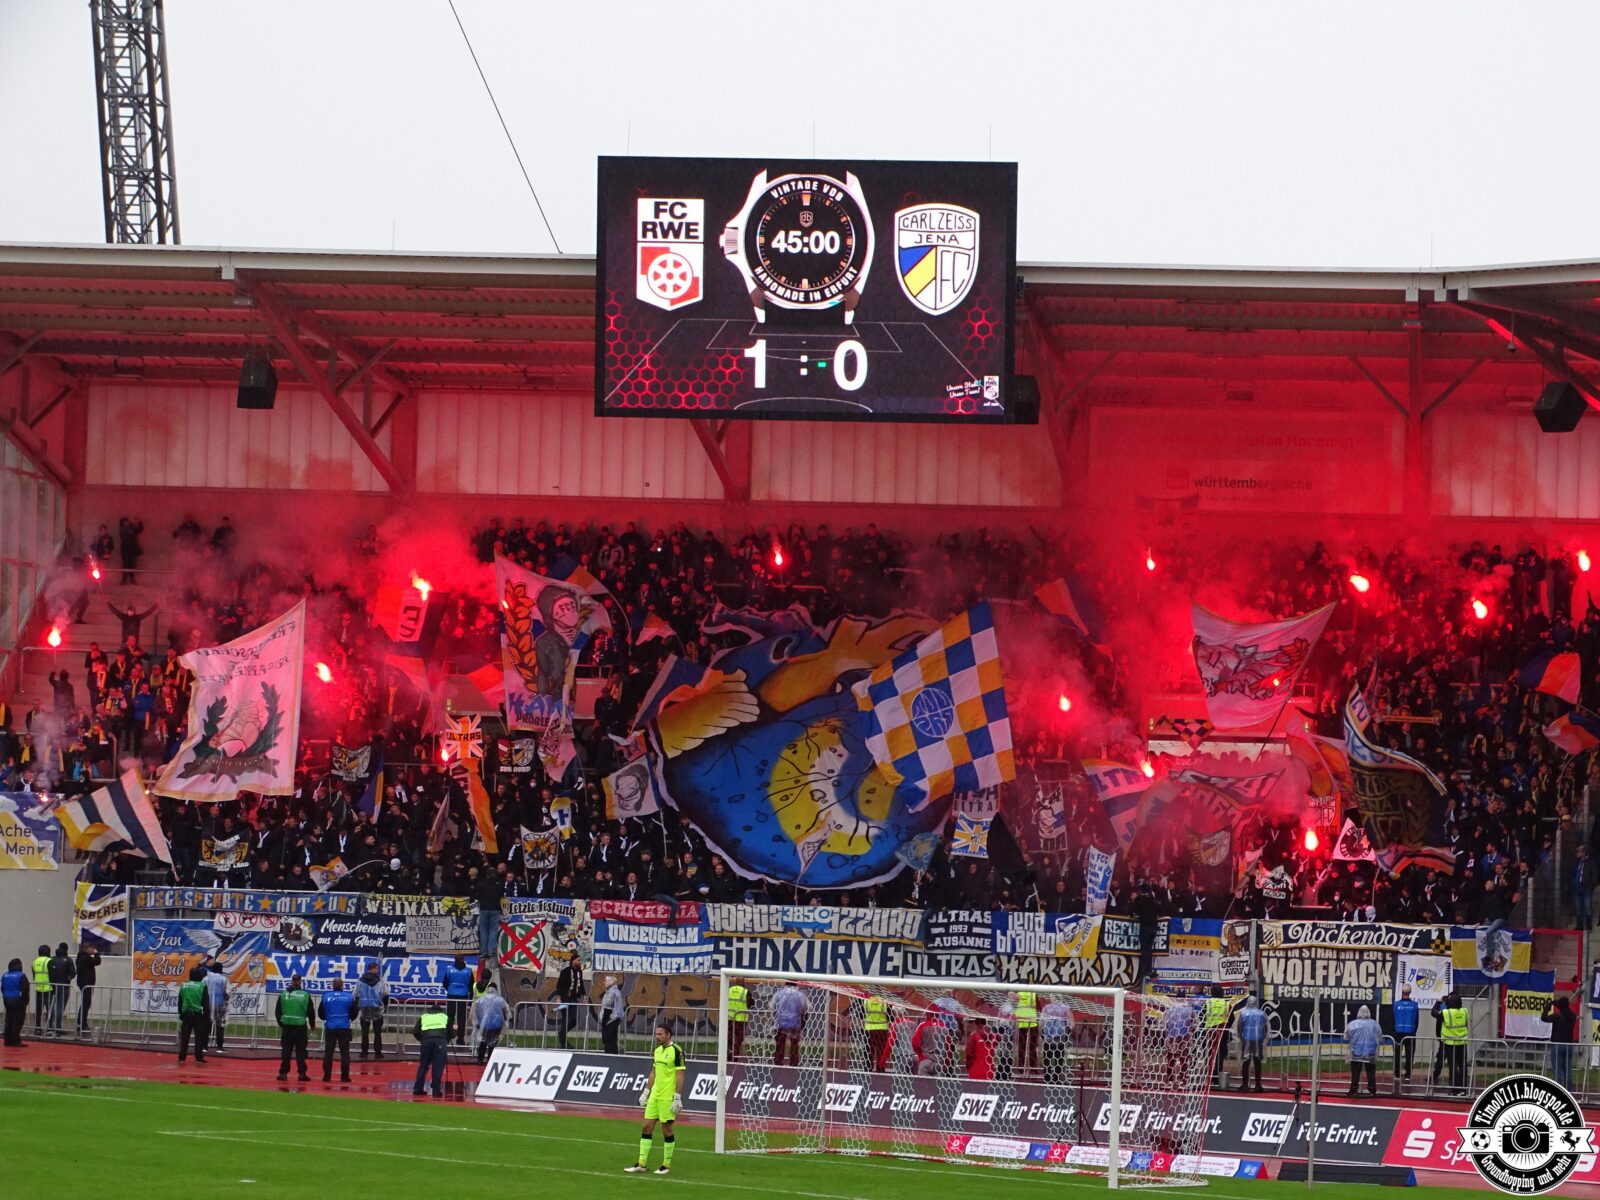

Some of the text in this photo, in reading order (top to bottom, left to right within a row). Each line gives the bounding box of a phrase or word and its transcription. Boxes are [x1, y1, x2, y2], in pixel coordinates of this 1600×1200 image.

[770, 180, 844, 202] VINTAGE VDB
[654, 201, 688, 220] FC
[641, 222, 699, 241] RWE
[771, 230, 841, 255] 45:00
[914, 234, 960, 245] JENA
[754, 265, 858, 302] HANDMADE IN ERFURT
[940, 250, 971, 302] FC
[744, 340, 767, 389] 1
[833, 340, 868, 391] 0
[6, 842, 35, 856] Men
[136, 889, 357, 914] AUSGESPERRTE MIT UNS
[366, 899, 446, 916] WEIMAR
[509, 901, 538, 915] Letzte
[538, 899, 577, 918] Festung
[590, 901, 699, 919] SCHICKEIA
[320, 918, 406, 936] Menschenrechte
[415, 919, 441, 927] SPIEL
[949, 924, 968, 934] 1993
[148, 925, 182, 952] Fan
[317, 936, 331, 946] aus
[334, 935, 351, 946] dem
[608, 924, 699, 945] UNBEUGSAM
[926, 936, 992, 949] LAUSANNE
[1287, 922, 1426, 954] Rockendorf
[150, 953, 185, 977] Club
[594, 952, 712, 974] UNVERKÄUFLICH
[711, 936, 902, 977] SÜDKURVE
[906, 953, 998, 978] ULTRAS
[1261, 957, 1393, 988] WOLFPACK
[1277, 985, 1374, 1001] FCC SUPPORTERS
[486, 1062, 562, 1087] NT.AG
[572, 1070, 603, 1089] SWE
[609, 1073, 632, 1091] Für
[734, 1081, 756, 1101] Für
[758, 1085, 801, 1103] Erfurt.
[825, 1088, 936, 1114] SWE Für Erfurt.
[959, 1098, 1075, 1124] SWE Für Erfurt.
[1145, 1114, 1169, 1132] Für
[1171, 1116, 1223, 1135] Erfurt.
[1248, 1118, 1379, 1147] SWE Für Erfurt.
